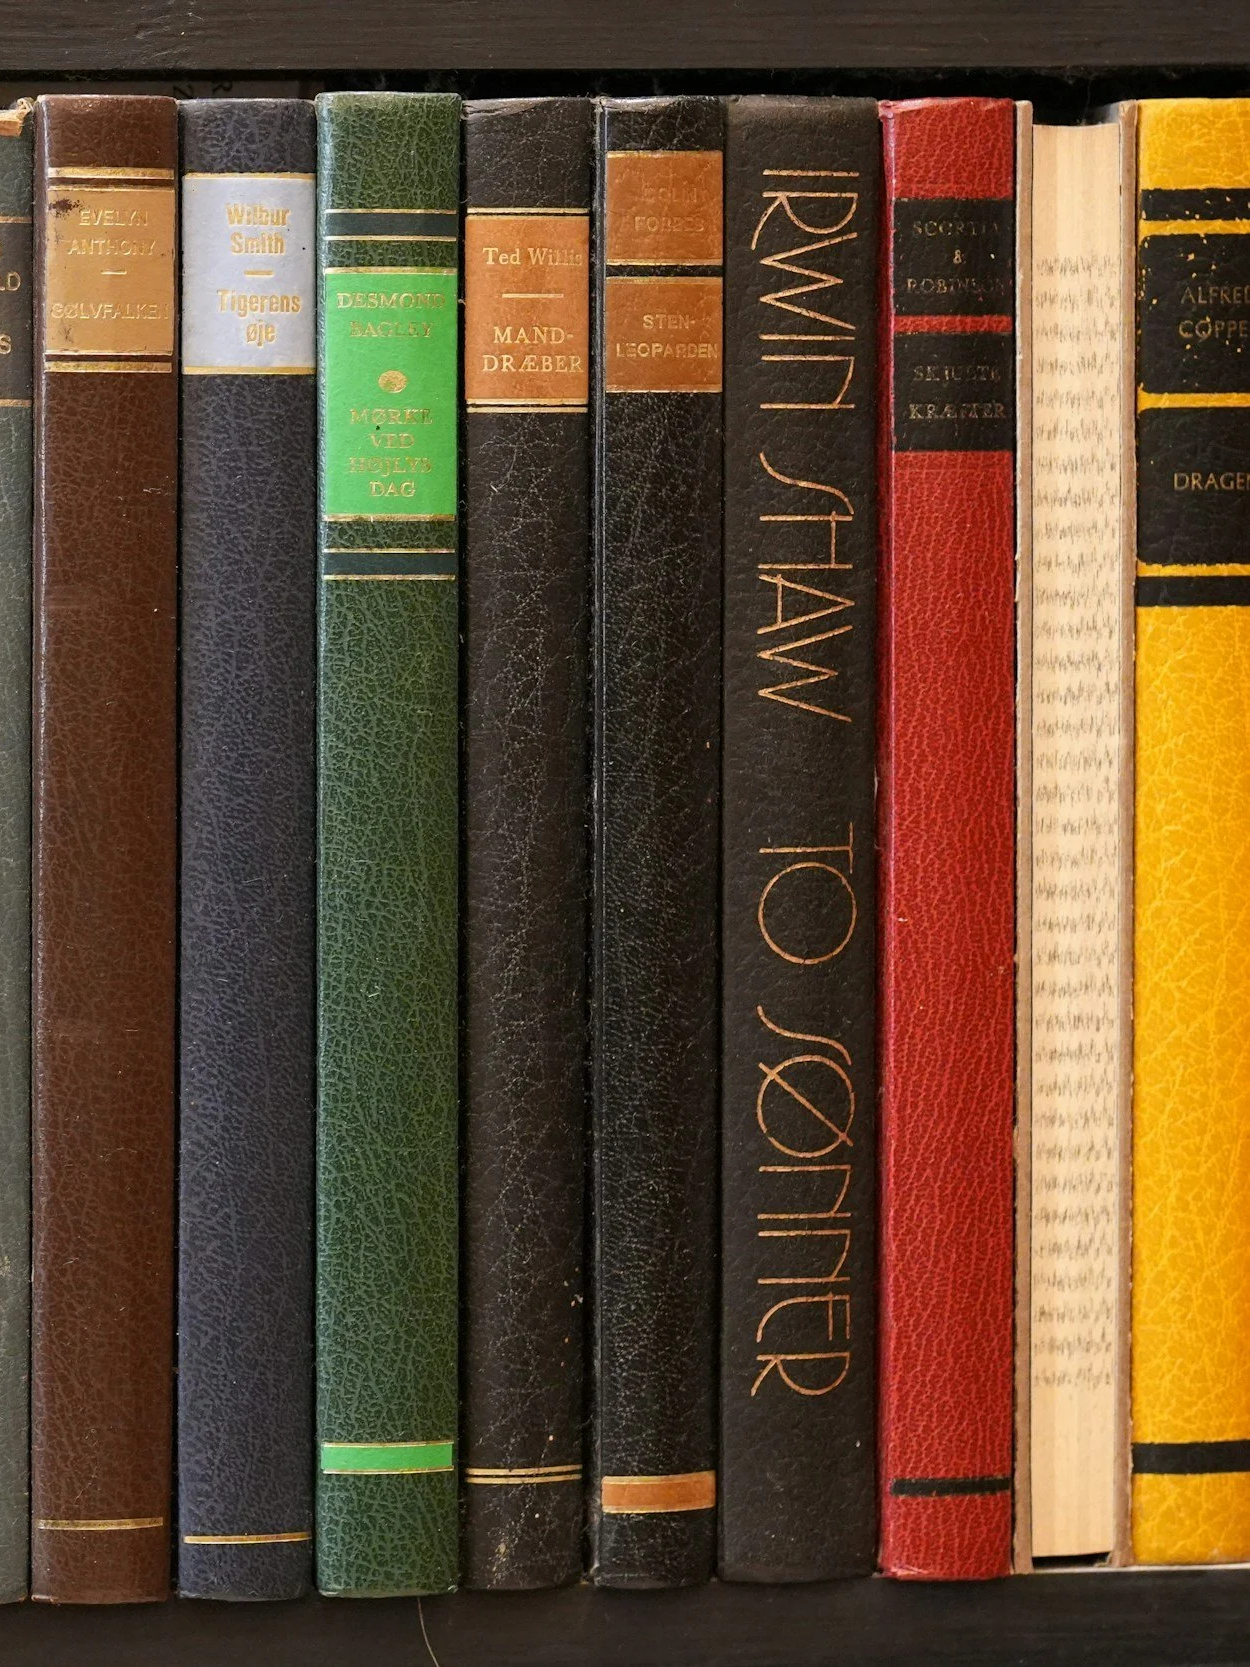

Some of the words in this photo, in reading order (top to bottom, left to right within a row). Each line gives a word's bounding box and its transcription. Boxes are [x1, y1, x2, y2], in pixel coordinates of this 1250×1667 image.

[79, 209, 149, 226] EVELYN
[226, 203, 291, 227] Wilbur
[67, 239, 157, 256] ANTHONY
[230, 231, 286, 255] Smith
[482, 247, 521, 265] Ted
[528, 247, 583, 266] Willis
[952, 248, 965, 265] &
[751, 168, 859, 410] IRWIN
[217, 288, 302, 318] Tigerens
[337, 292, 446, 309] DESMOND
[350, 321, 435, 338] BAGLEY
[642, 313, 696, 330] STEN-
[246, 319, 277, 348] øje
[493, 327, 574, 344] MAND-
[616, 342, 718, 359] LEOPARDEN
[482, 354, 584, 373] DRÆBER
[350, 408, 433, 425] MØRKE
[369, 432, 415, 449] VED
[349, 457, 433, 477] HØJLYS
[369, 481, 416, 498] DAG
[1173, 472, 1250, 491] DRAGE
[757, 452, 854, 723] SHAW
[758, 822, 857, 965] TO
[751, 1004, 855, 1397] SØNNER
